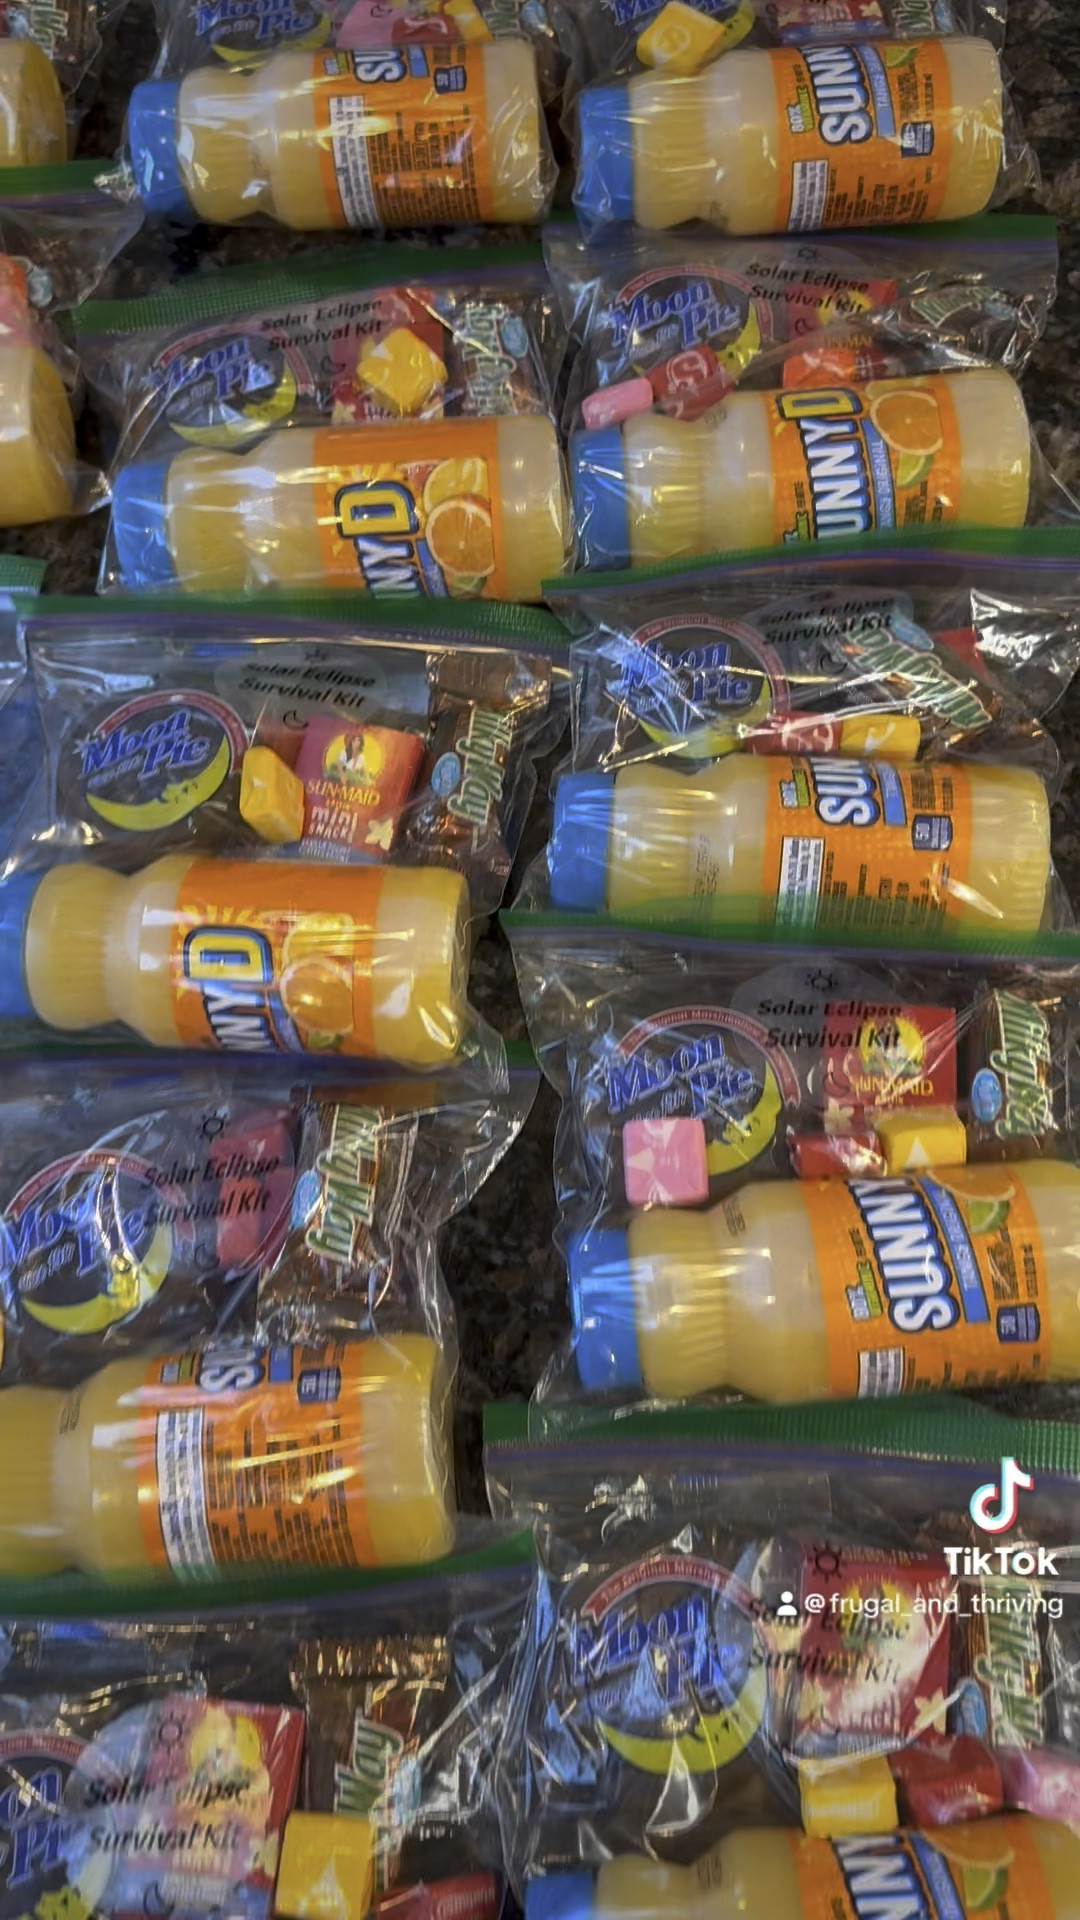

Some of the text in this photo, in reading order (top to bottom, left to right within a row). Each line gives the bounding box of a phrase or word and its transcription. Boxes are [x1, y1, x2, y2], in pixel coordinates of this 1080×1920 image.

[747, 263, 870, 292] Solar Eclipse
[262, 299, 383, 333] Solar Eclipse
[750, 285, 865, 314] Survival Kit
[268, 319, 383, 351] Survival Kit
[681, 303, 742, 349] Pie
[776, 386, 873, 538] UNNYD
[763, 614, 894, 645] Survival Kit
[239, 676, 366, 708] Survival Kit
[241, 663, 377, 688] Solar Eclipse
[79, 709, 192, 779] Moon
[137, 732, 211, 780] Pie
[757, 1000, 903, 1020] Solar Eclipse
[764, 1027, 903, 1049] Survival Kit
[606, 1032, 725, 1113] Moon
[141, 1154, 281, 1189] Solar Eclipse
[144, 1187, 272, 1228] Survival Kit
[844, 1177, 960, 1332] SUNNY
[91, 1821, 242, 1852] Survival Kit
